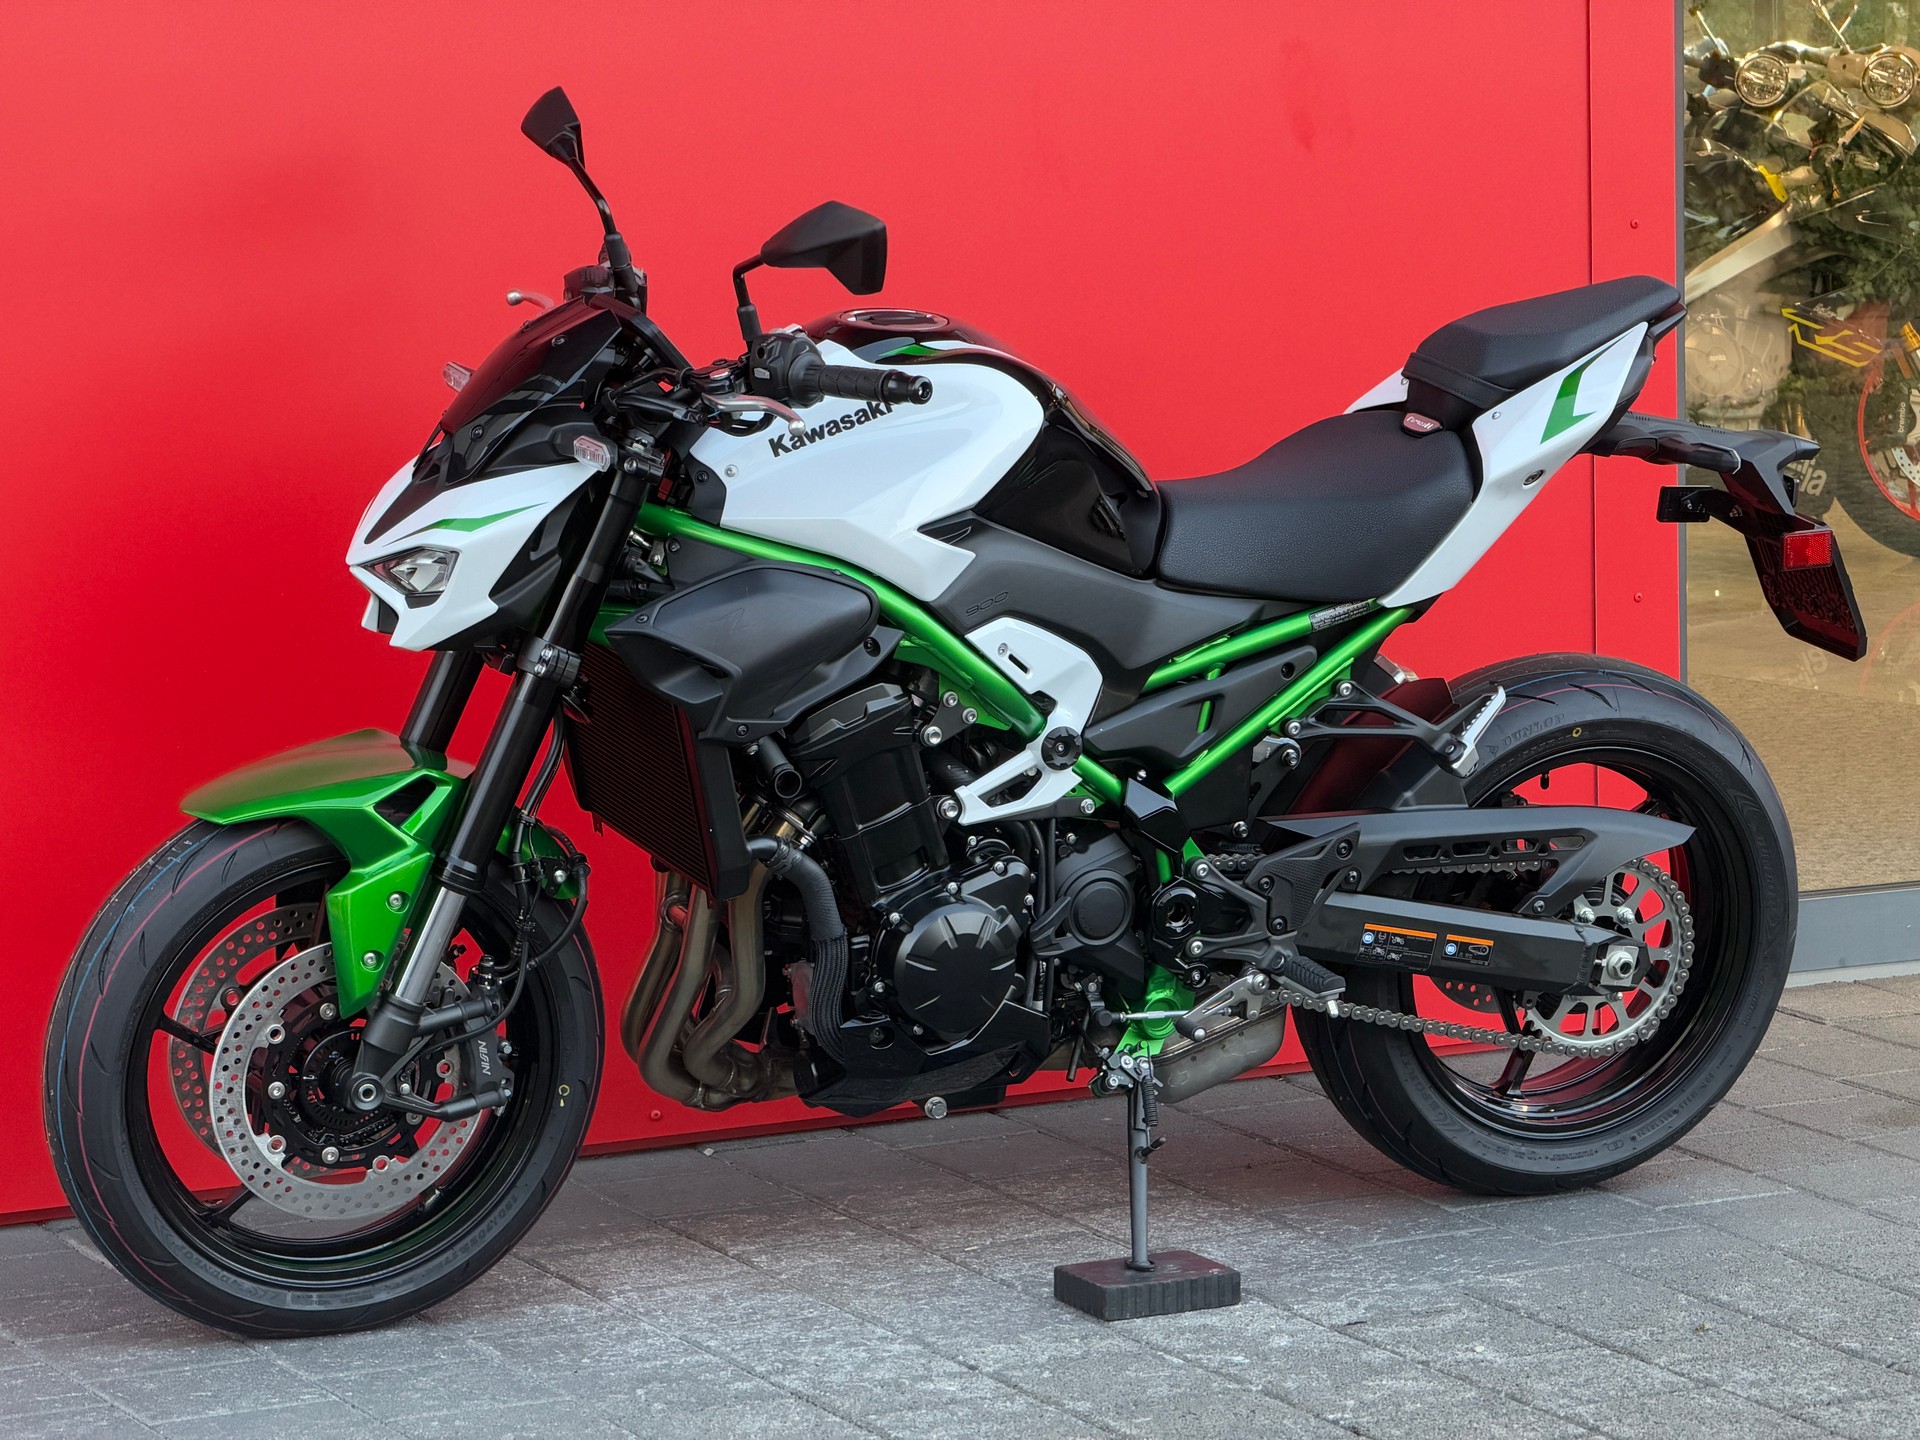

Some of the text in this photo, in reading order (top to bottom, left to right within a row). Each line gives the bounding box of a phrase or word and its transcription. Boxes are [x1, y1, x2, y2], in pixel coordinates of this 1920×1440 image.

[768, 401, 893, 458] Kawasaki
[1897, 401, 1906, 433] brembo
[966, 591, 1009, 617] 900
[1503, 713, 1565, 747] DUNLOP
[477, 1039, 492, 1076] NISSIN
